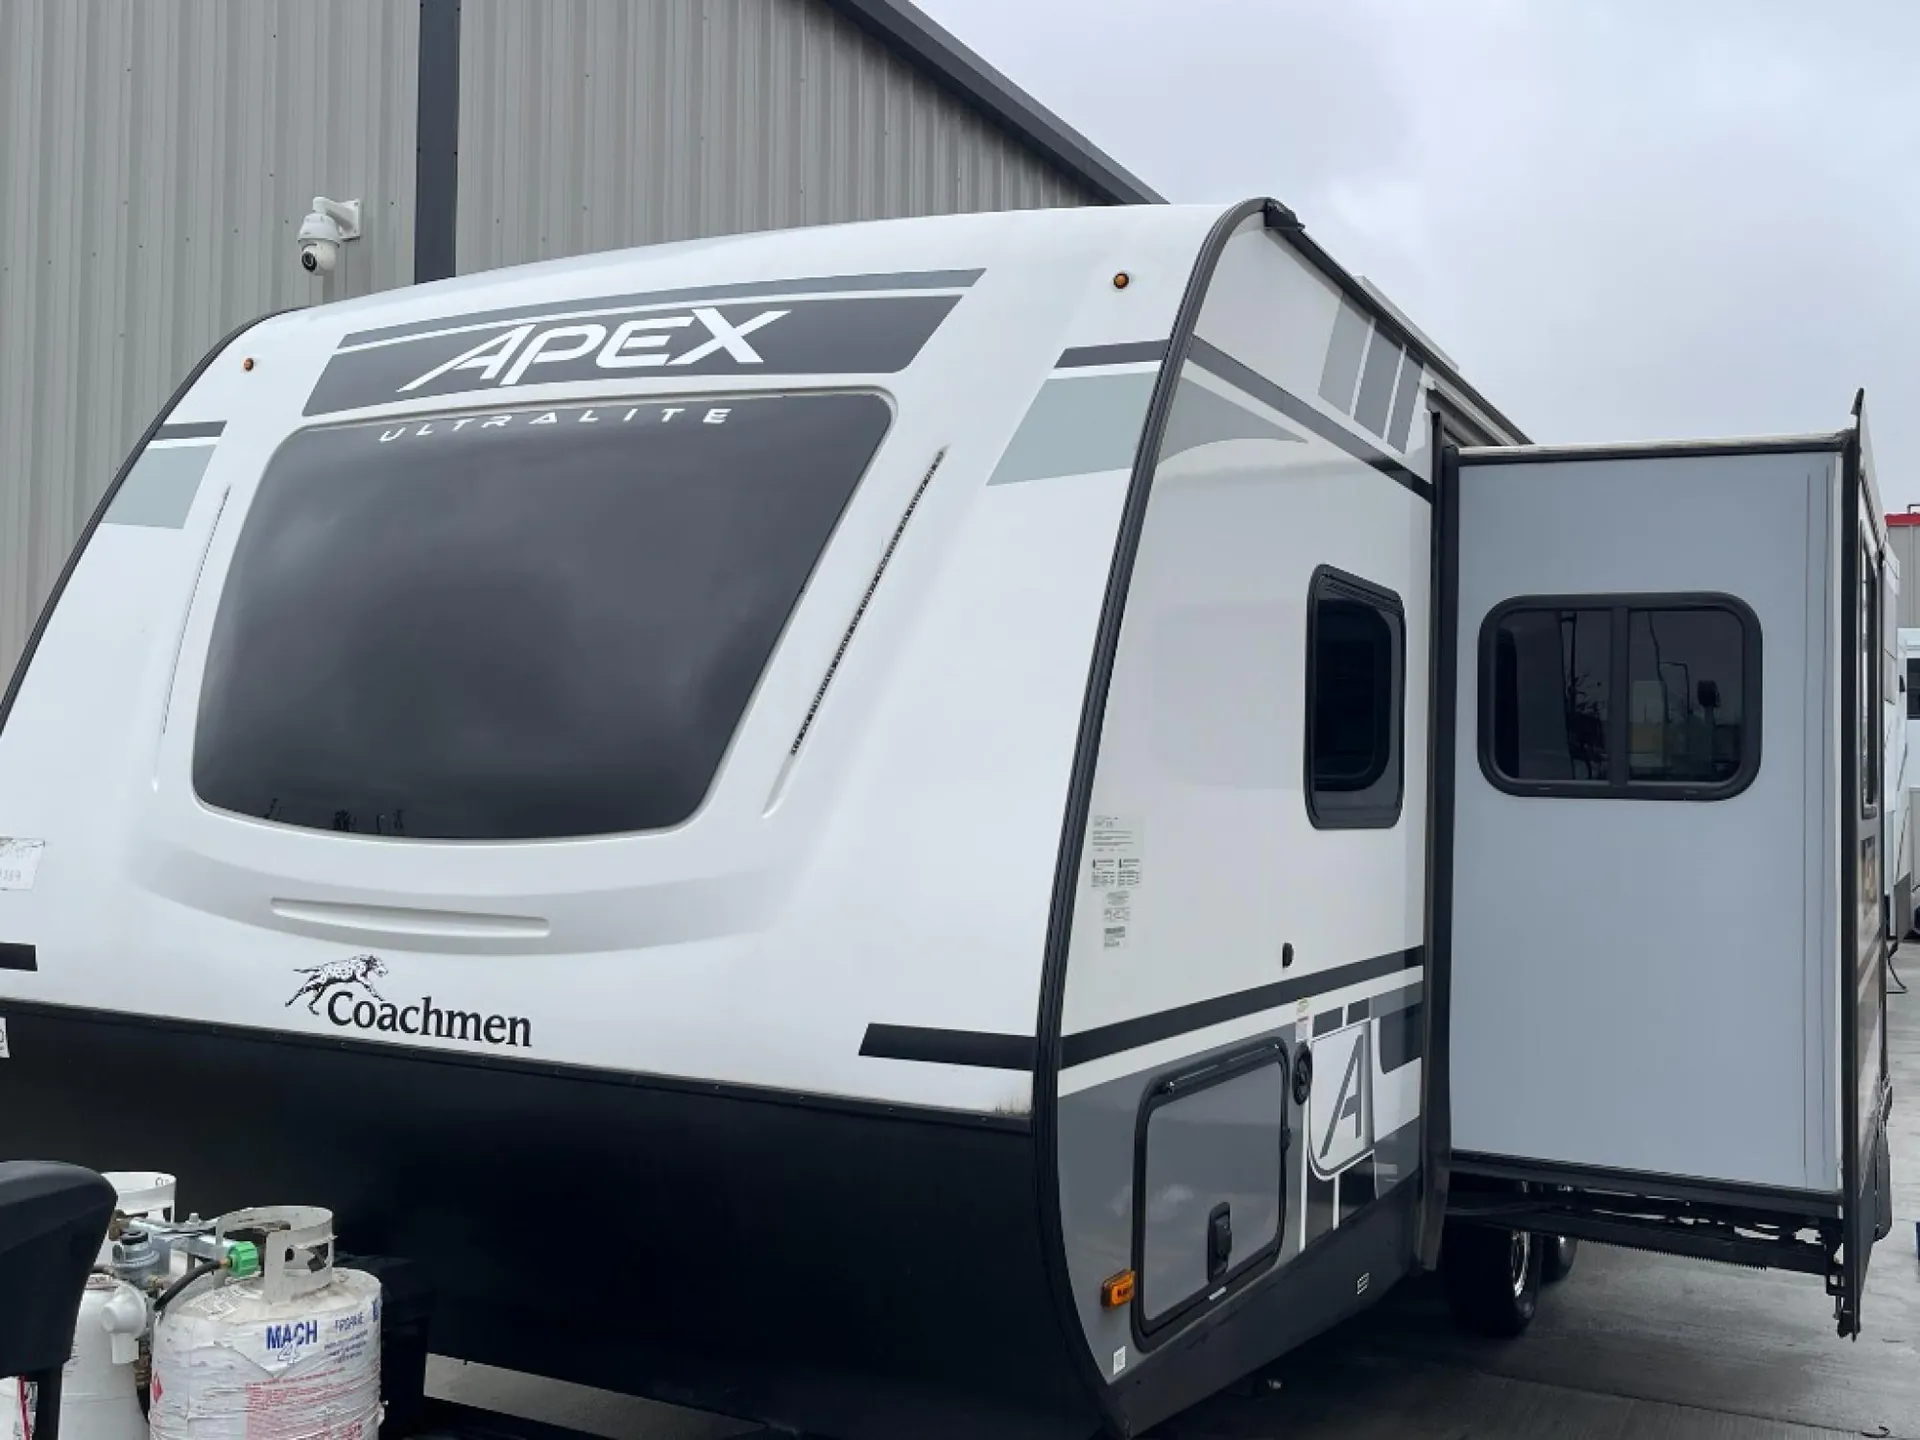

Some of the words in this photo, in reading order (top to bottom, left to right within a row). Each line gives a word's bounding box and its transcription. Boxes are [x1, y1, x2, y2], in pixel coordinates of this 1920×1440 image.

[396, 307, 792, 393] APEX
[380, 408, 733, 443] ULTRALITE
[327, 990, 532, 1048] Coachmen
[266, 1319, 318, 1350] MACH
